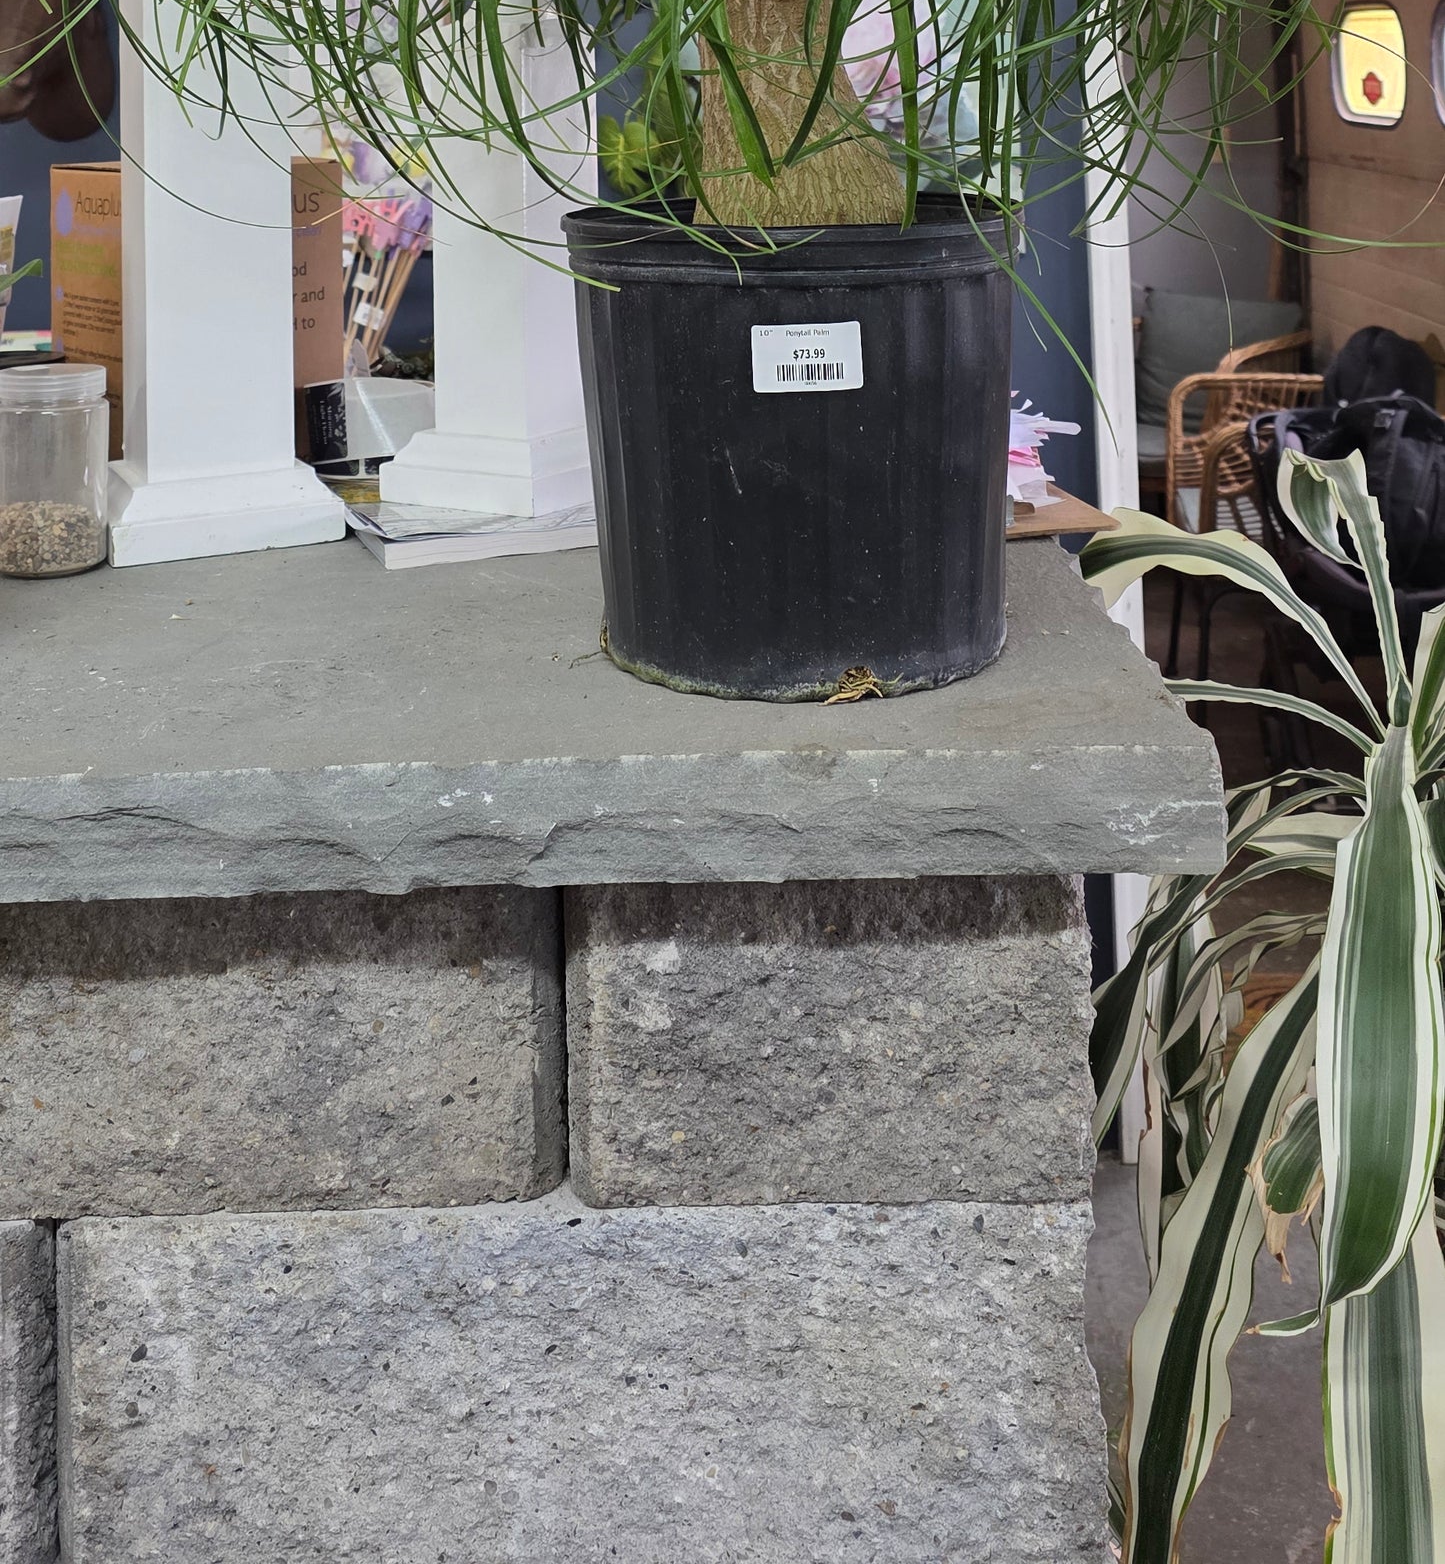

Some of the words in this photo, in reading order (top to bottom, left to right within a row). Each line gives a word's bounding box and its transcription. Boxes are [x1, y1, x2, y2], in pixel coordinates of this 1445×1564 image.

[75, 191, 121, 222] Aquaplu
[301, 286, 325, 303] and
[301, 317, 316, 330] to
[785, 329, 811, 337] Ponytail
[793, 348, 826, 362] $73.99
